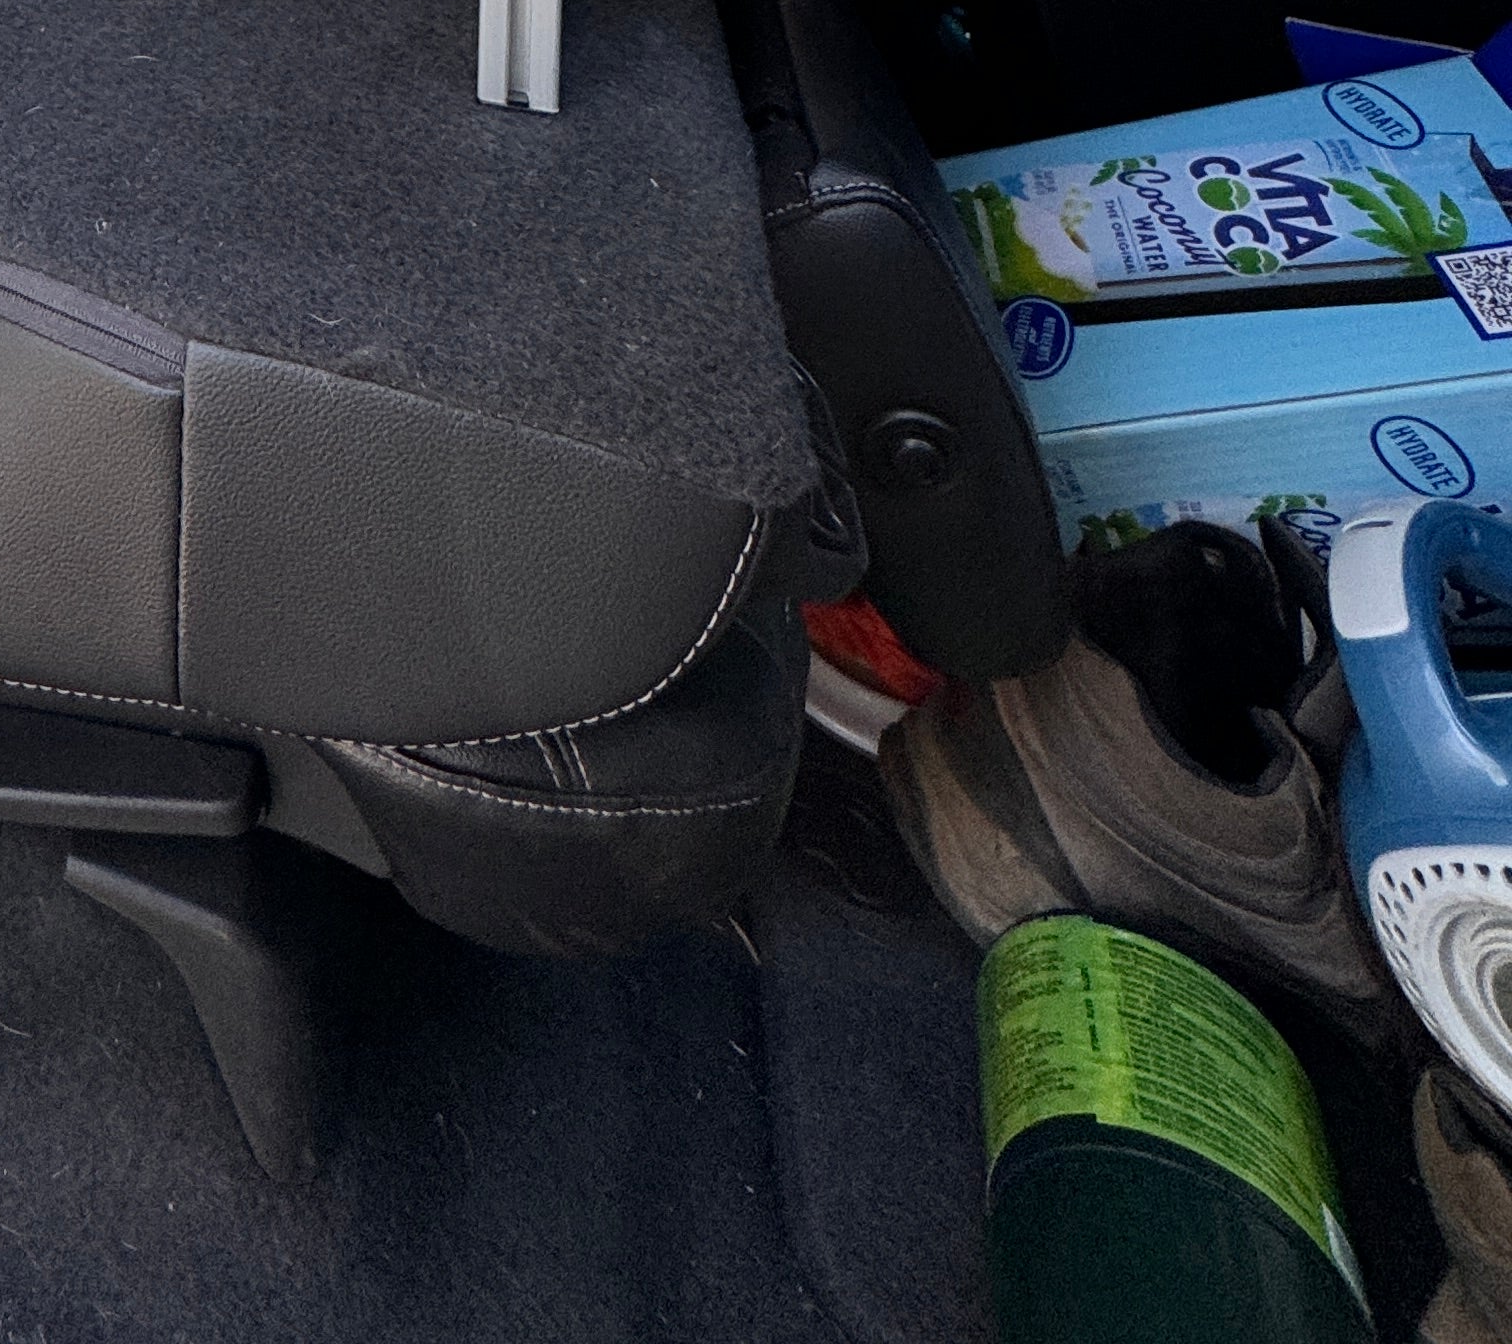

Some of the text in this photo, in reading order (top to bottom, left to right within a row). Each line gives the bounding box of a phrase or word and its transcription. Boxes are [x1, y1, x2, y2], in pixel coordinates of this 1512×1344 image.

[1336, 87, 1412, 141] HYDRATE
[1103, 198, 1137, 276] THE ORIGINAL
[1117, 169, 1237, 270] Coconut
[1132, 214, 1169, 273] WATER
[1189, 156, 1281, 275] COCO
[1247, 153, 1340, 261] VITA
[1386, 425, 1461, 491] HYDRATE
